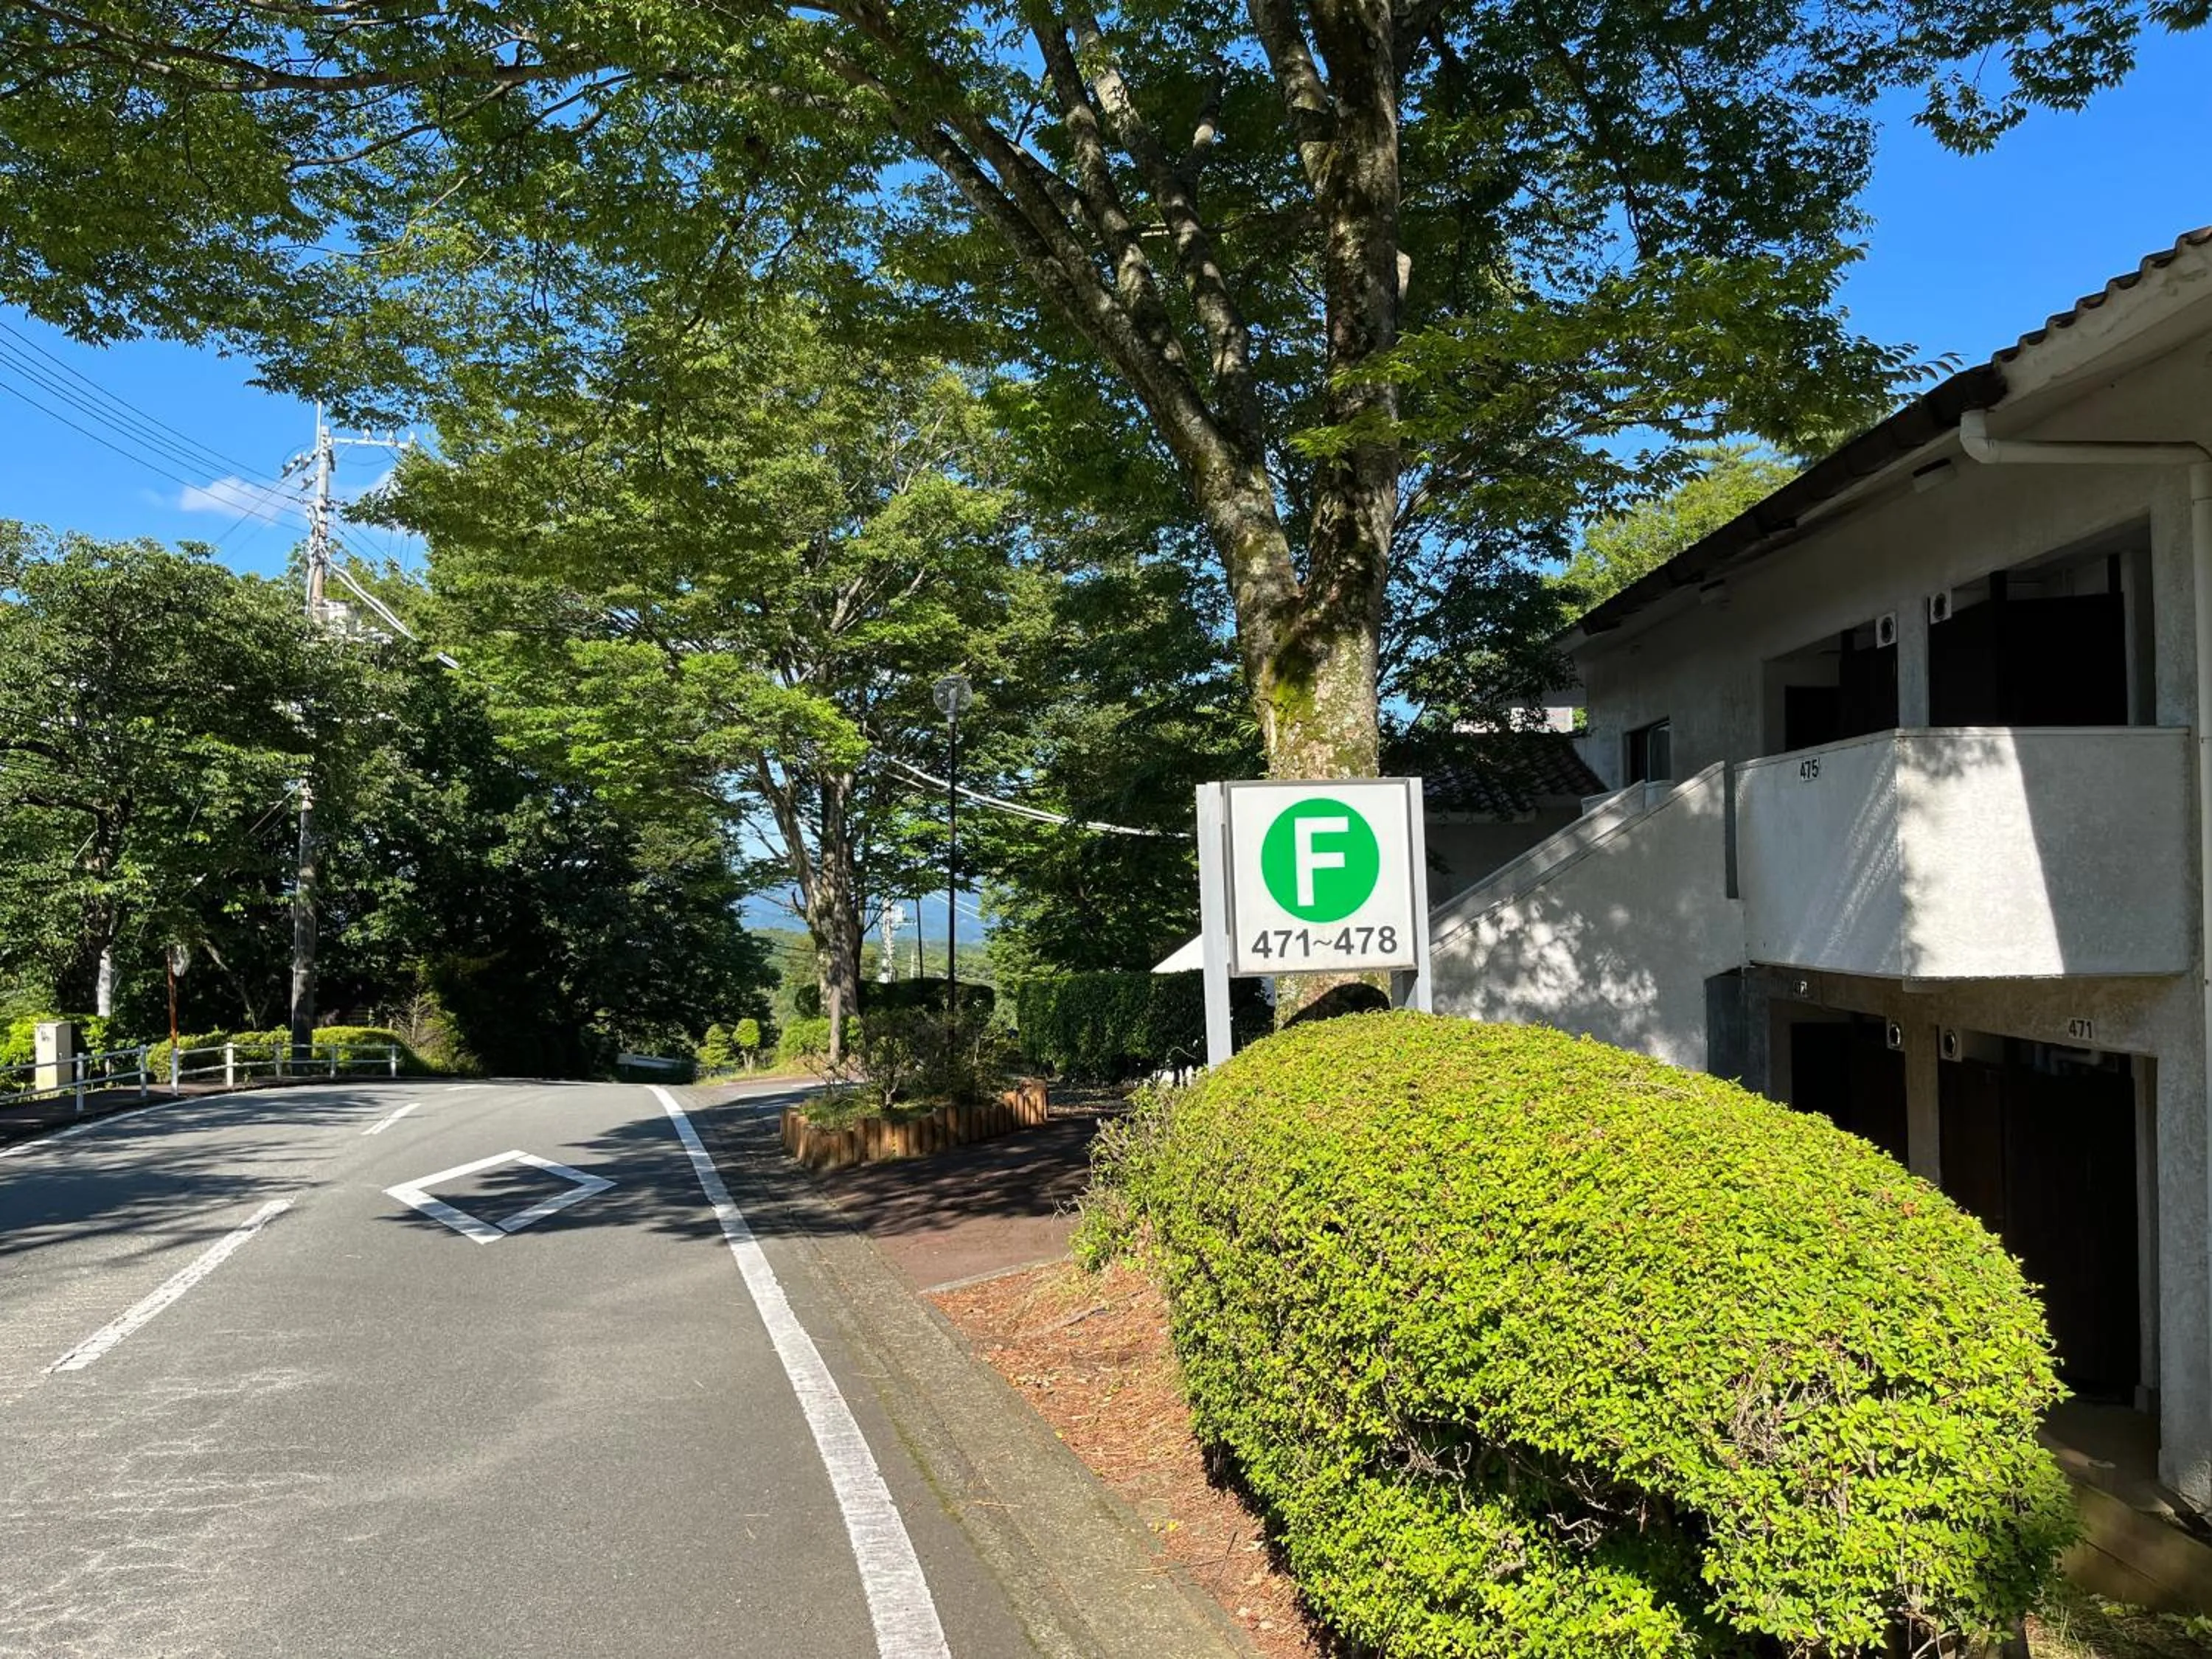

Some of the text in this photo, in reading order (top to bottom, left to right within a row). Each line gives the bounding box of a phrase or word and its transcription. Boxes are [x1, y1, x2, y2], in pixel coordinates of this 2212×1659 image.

[1800, 759, 1819, 779] 475
[1294, 816, 1349, 906] F
[2069, 1020, 2093, 1039] 471
